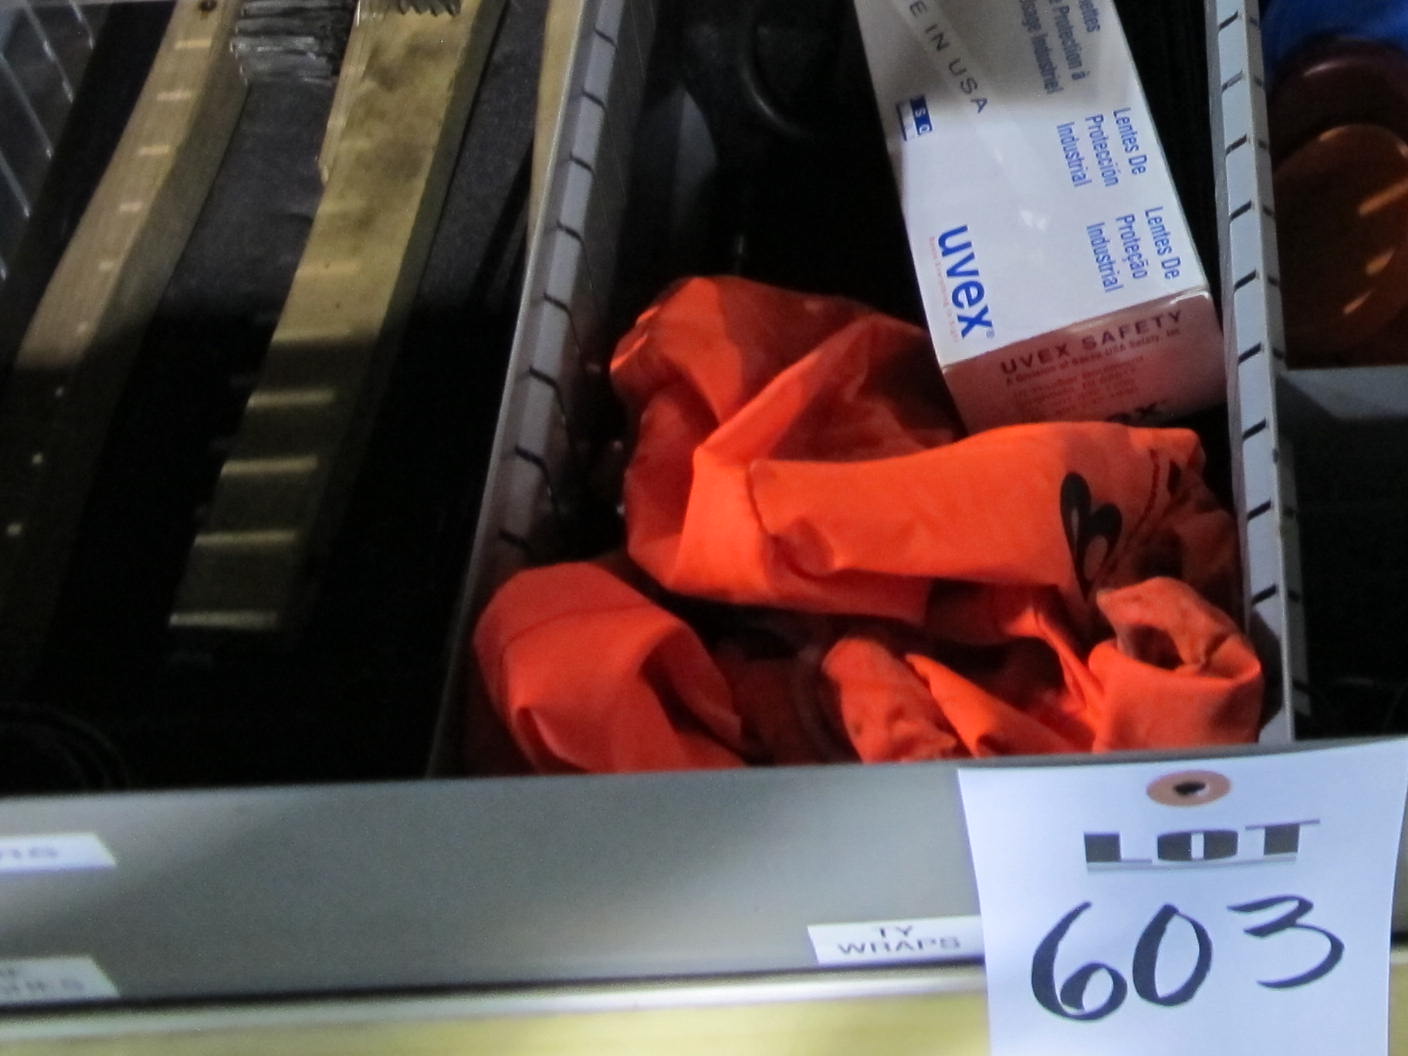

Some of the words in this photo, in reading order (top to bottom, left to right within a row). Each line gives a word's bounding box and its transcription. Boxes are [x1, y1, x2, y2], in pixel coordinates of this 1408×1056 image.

[925, 23, 952, 53] IN
[947, 57, 988, 114] USA
[1056, 121, 1093, 188] Industrial
[1085, 114, 1122, 187] Protección
[1112, 107, 1140, 154] Lentes
[1128, 154, 1148, 175] De
[1086, 222, 1125, 294] Industrial
[1115, 213, 1149, 280] Proteção
[1144, 206, 1173, 256] Lentes
[1161, 256, 1182, 280] De
[938, 224, 993, 339] uvex
[1000, 343, 1071, 375] UVEX
[1081, 310, 1182, 351] SAFETY
[1083, 819, 1321, 872] LOT
[1031, 894, 1345, 1022] 603
